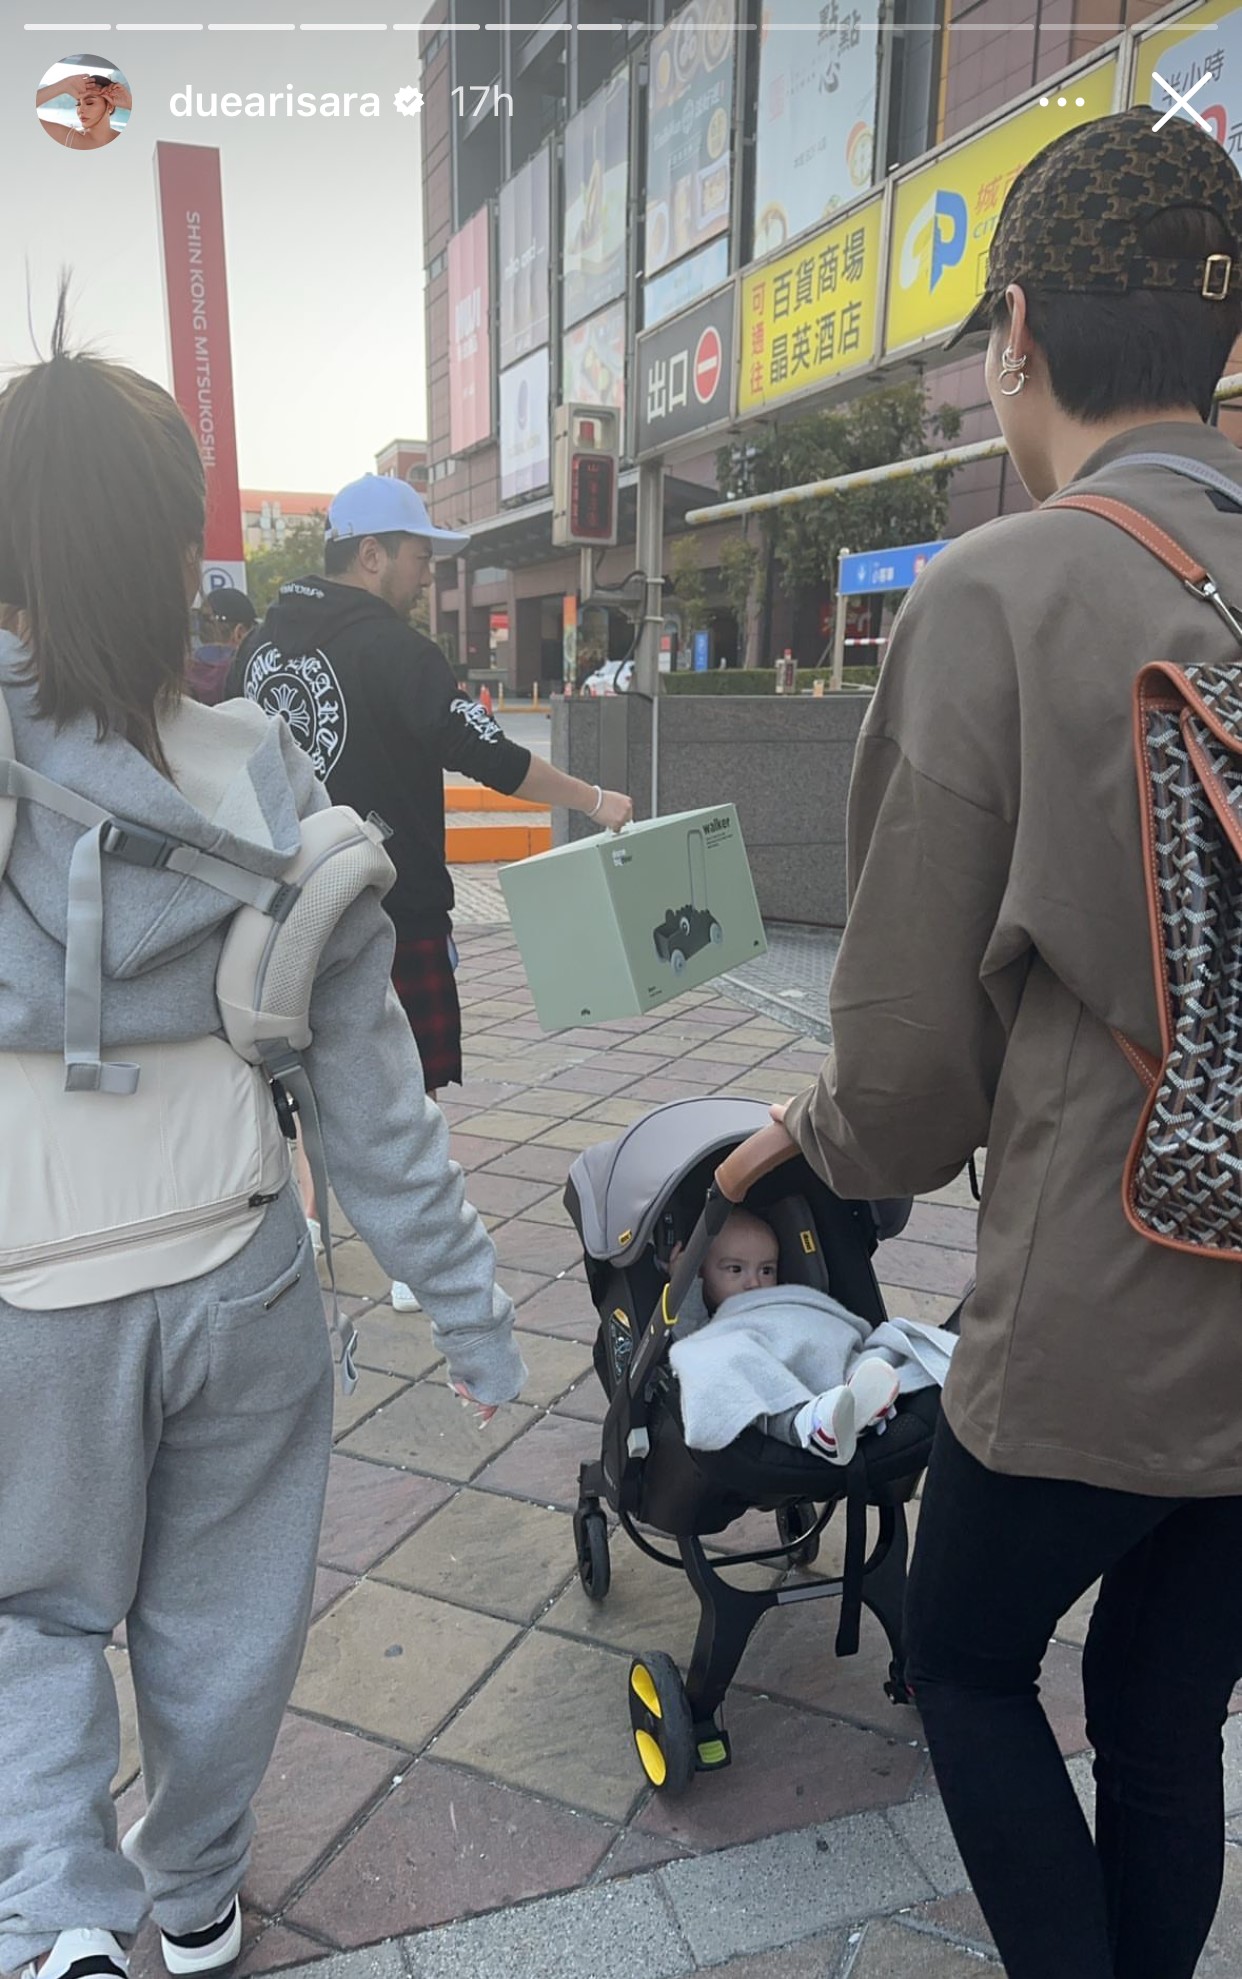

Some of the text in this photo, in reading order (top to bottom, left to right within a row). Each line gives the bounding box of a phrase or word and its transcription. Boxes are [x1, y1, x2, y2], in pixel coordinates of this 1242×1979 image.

[773, 227, 865, 322] 百貨商場
[186, 211, 216, 467] SHIN KONG MITSUKOSHI
[770, 301, 862, 385] 晶英酒店
[647, 349, 689, 424] 出口
[702, 817, 730, 835] walker
